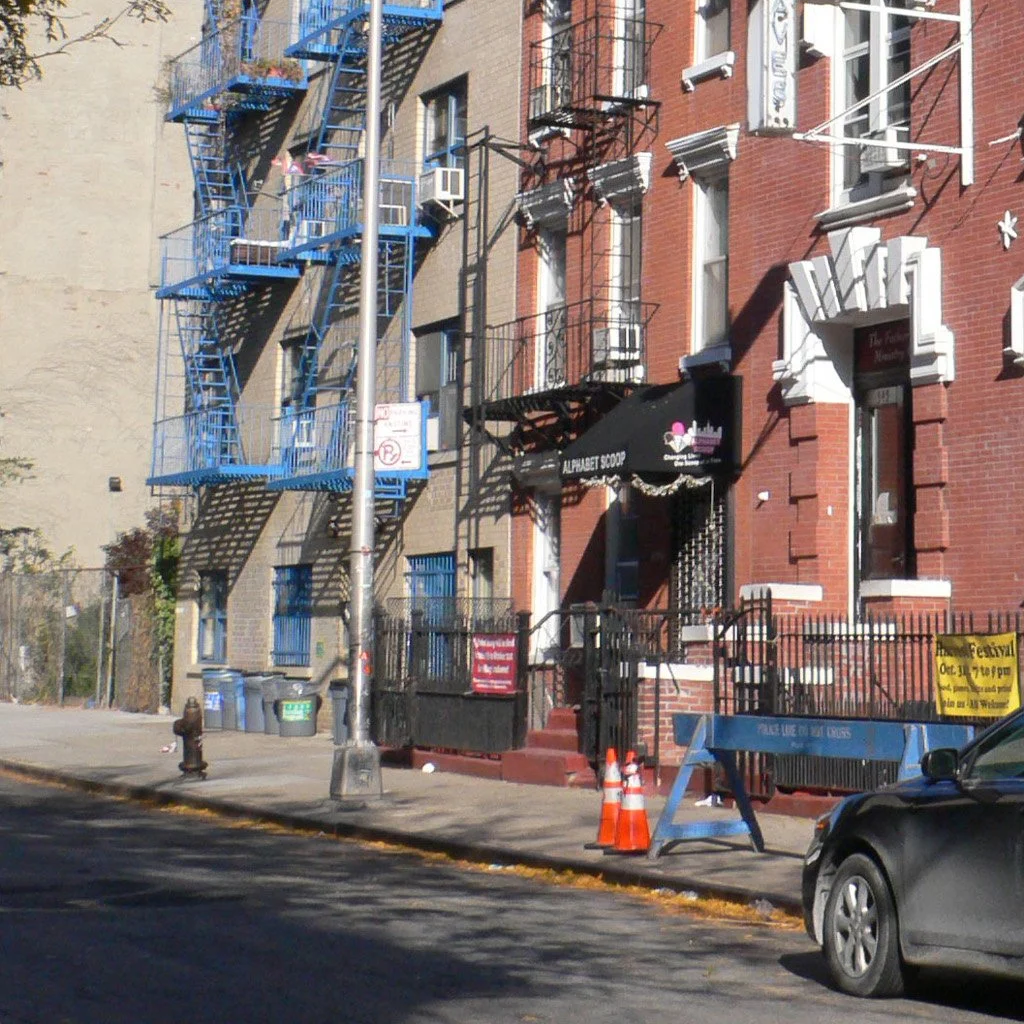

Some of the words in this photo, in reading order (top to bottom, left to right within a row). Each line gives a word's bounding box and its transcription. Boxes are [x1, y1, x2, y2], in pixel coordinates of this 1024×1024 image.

[562, 455, 599, 474] ALPHABET
[600, 450, 627, 469] SCOOP
[969, 639, 1015, 659] Festival
[757, 723, 780, 736] POLICE
[781, 723, 797, 737] LINE
[826, 725, 852, 739] CROSS
